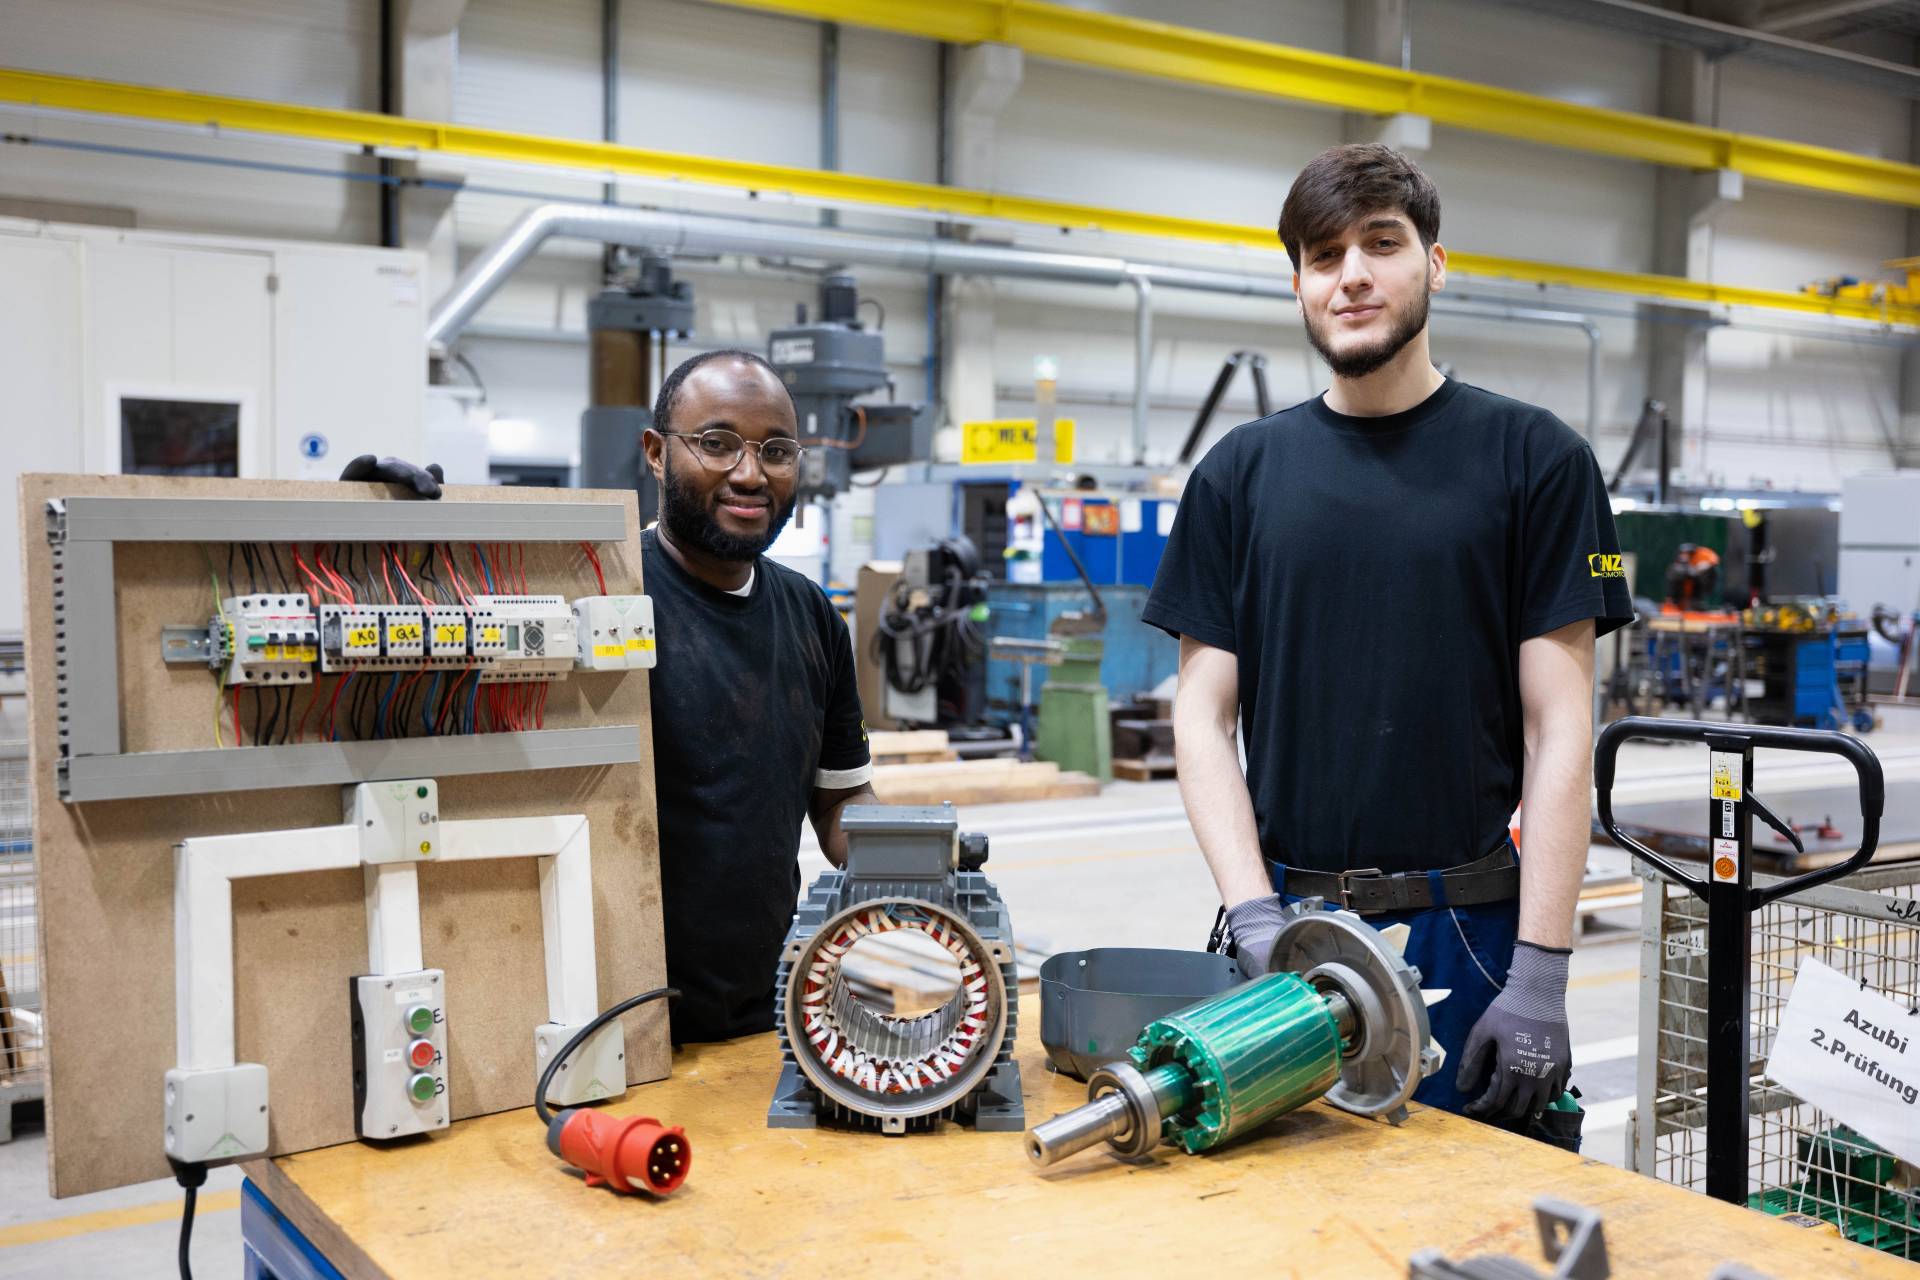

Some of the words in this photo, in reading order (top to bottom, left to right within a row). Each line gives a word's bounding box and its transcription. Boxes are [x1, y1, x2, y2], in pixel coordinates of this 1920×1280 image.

[1600, 554, 1624, 571] NZ
[396, 626, 420, 641] Q1
[432, 1008, 444, 1024] E
[1843, 1008, 1909, 1054] Azubi
[1810, 1028, 1919, 1105] 2.Prüfung
